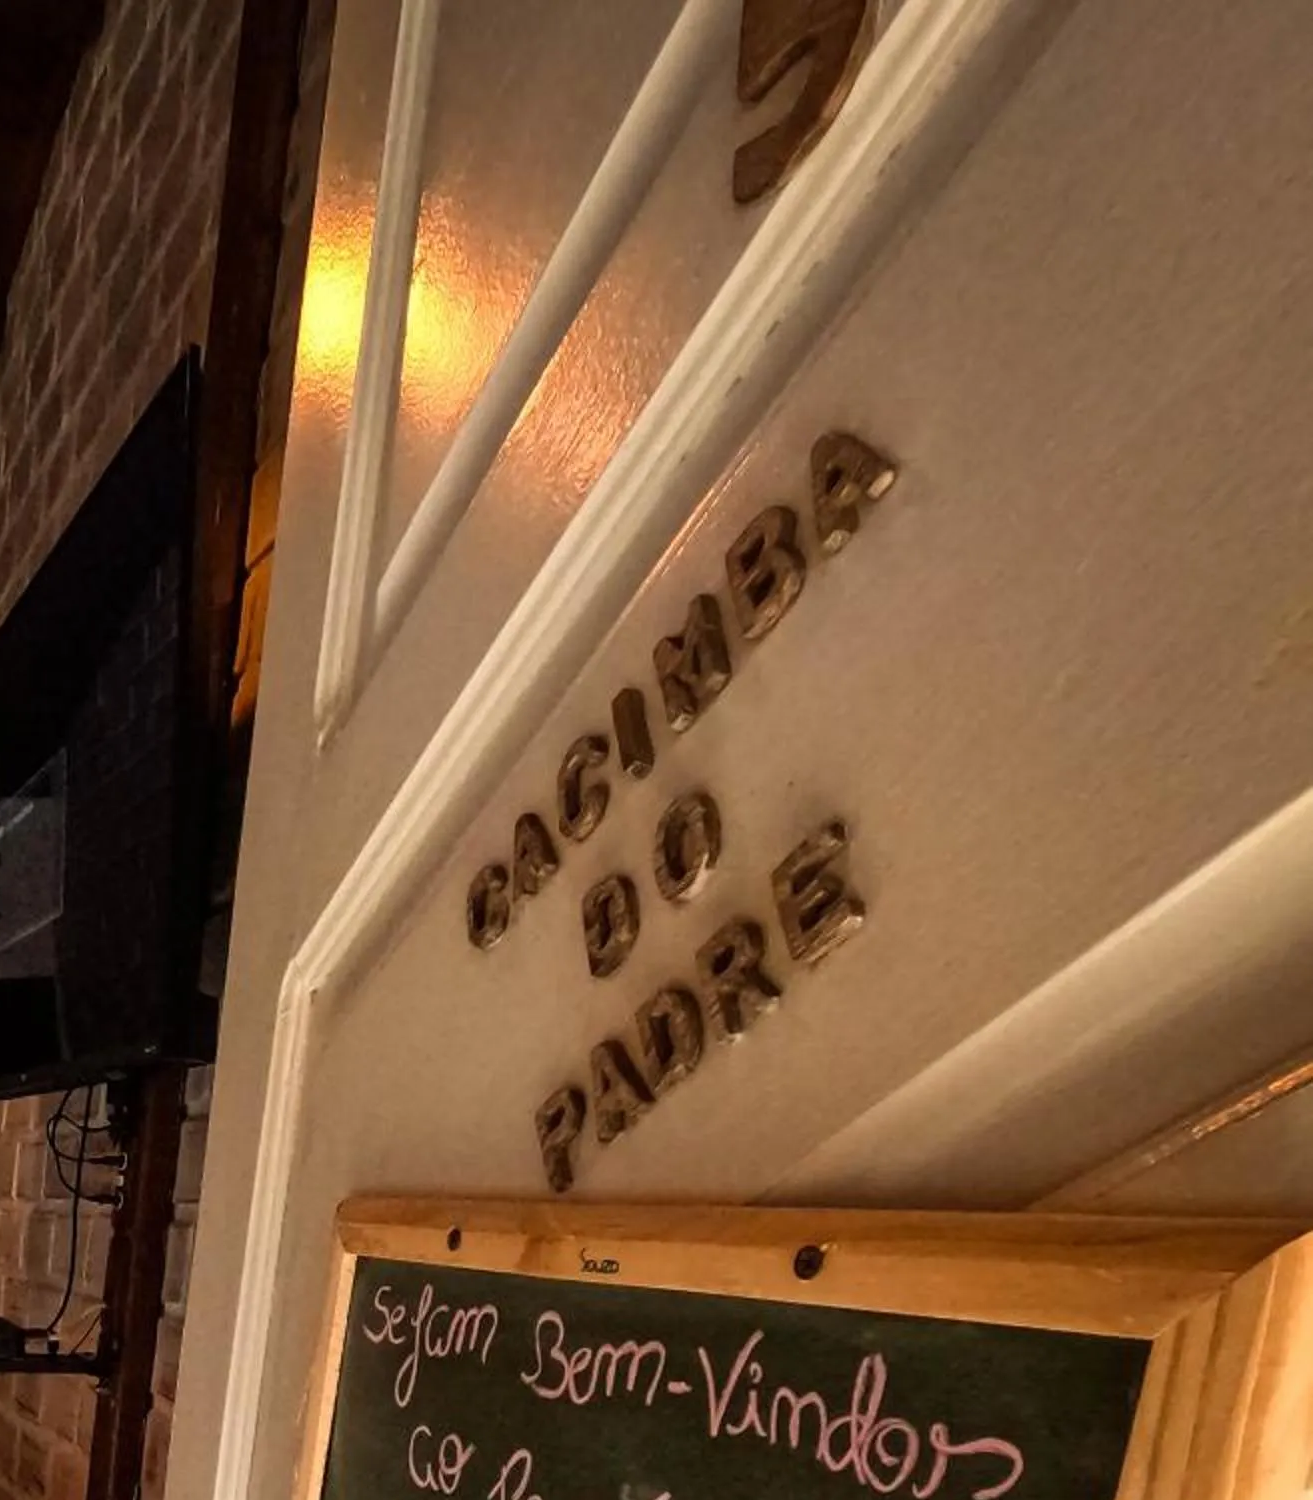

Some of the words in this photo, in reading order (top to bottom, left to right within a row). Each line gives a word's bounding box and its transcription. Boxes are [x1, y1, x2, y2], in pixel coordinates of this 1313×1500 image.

[467, 431, 897, 951] CACIMBA
[582, 791, 721, 977] DO
[535, 818, 866, 1193] PADRE
[363, 1284, 498, 1406] Sejam
[408, 1425, 476, 1494] ao
